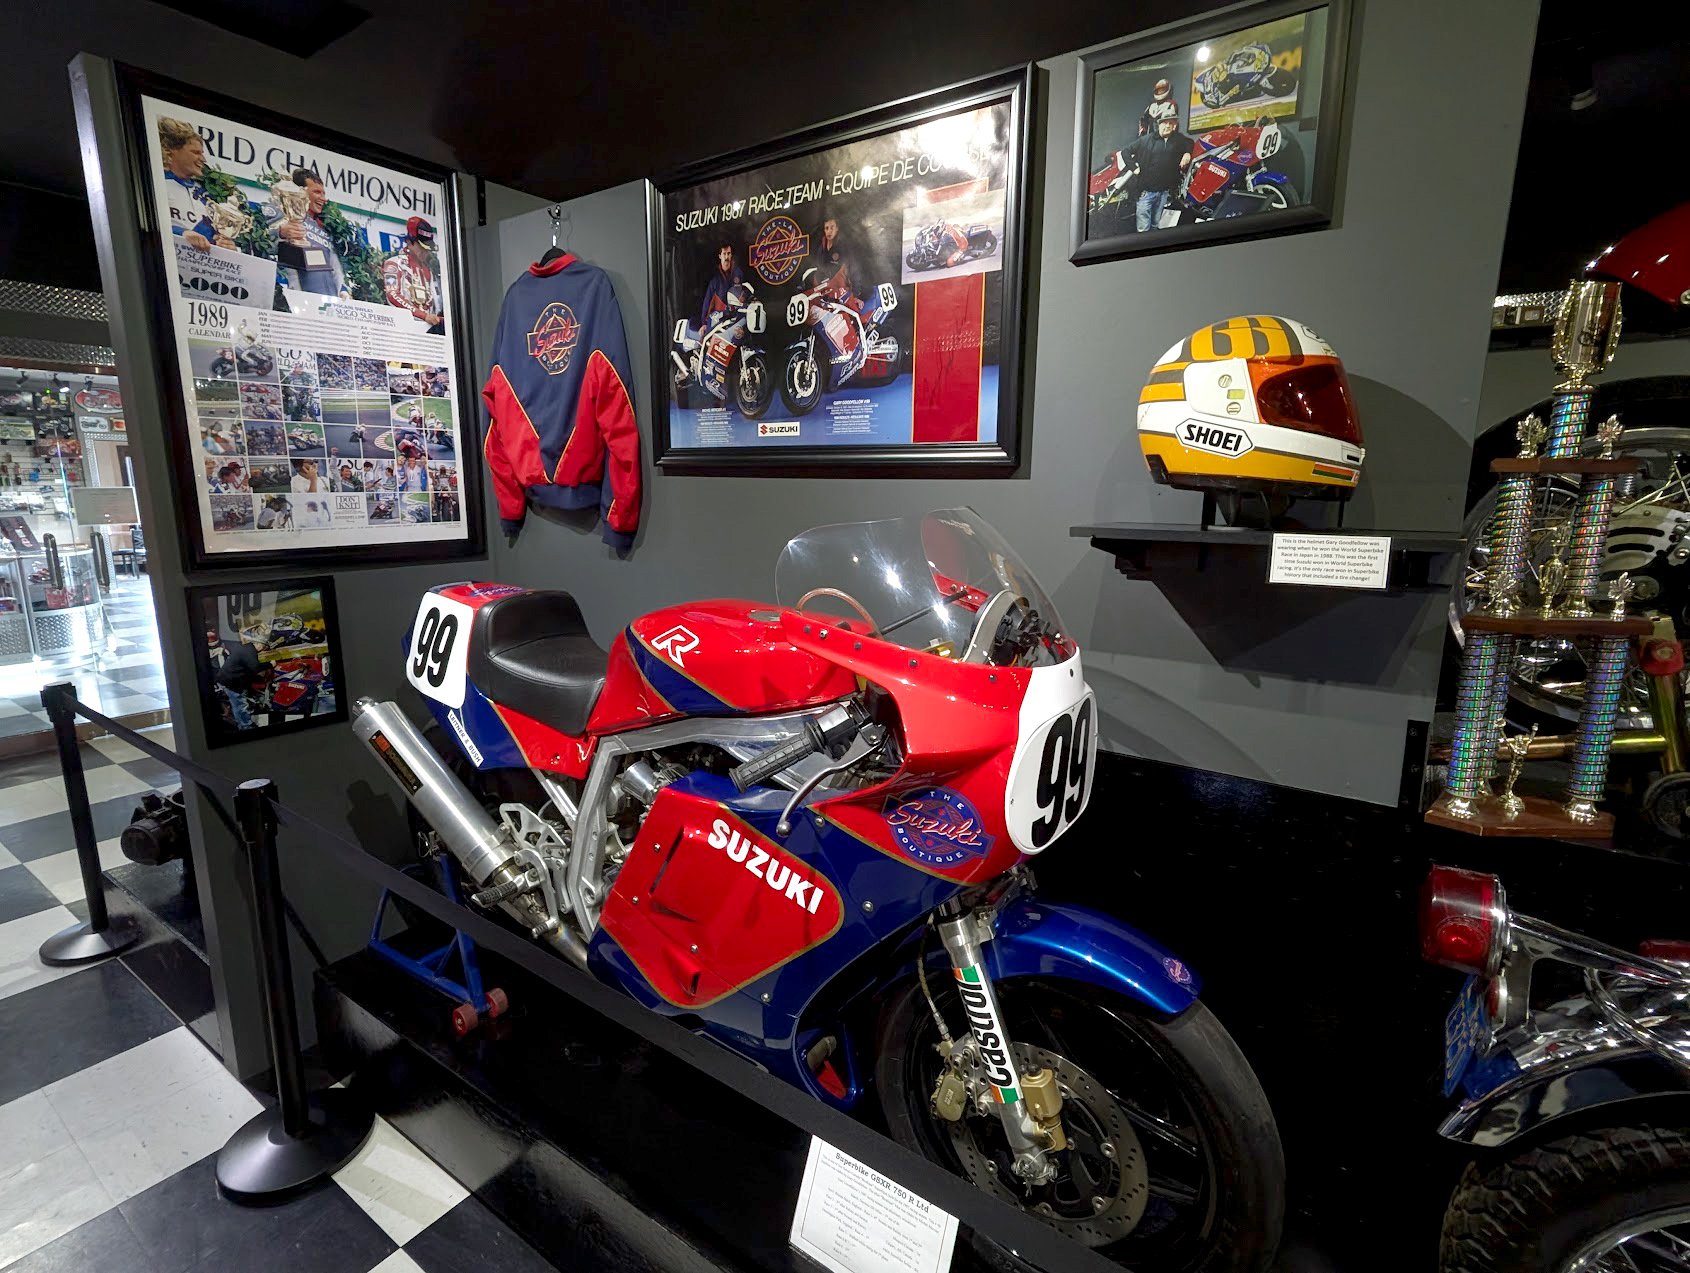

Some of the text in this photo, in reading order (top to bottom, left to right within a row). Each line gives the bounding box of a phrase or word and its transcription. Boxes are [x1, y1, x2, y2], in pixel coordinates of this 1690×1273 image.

[1261, 131, 1279, 158] 99
[266, 147, 436, 216] CHAMPIONSHI
[675, 205, 719, 232] SUZUKI
[721, 199, 746, 222] 1987
[748, 189, 785, 215] RACE
[786, 179, 824, 205] TEAM
[892, 157, 915, 182] DE
[185, 251, 243, 271] SUPERBIKE
[752, 229, 804, 268] Suzuki
[789, 300, 805, 325] 99
[881, 286, 895, 308] 99
[188, 301, 228, 328] 1989
[675, 320, 684, 341] 1
[753, 305, 762, 331] 1
[188, 327, 231, 339] CALENDAR
[768, 424, 799, 434] SUZUKI
[1184, 423, 1243, 452] SHOEI
[412, 606, 459, 688] 99
[651, 624, 700, 668] R
[1031, 697, 1092, 848] 99
[930, 791, 965, 810] THE
[887, 800, 983, 846] Suzuki
[897, 827, 963, 863] BOUTIQUE
[707, 818, 825, 915] SUZUKI
[957, 981, 1013, 1087] Castrol
[835, 1152, 869, 1177] Superbike
[893, 1186, 907, 1200] 750
[908, 1195, 915, 1204] R
[916, 1200, 929, 1213] Ltd
